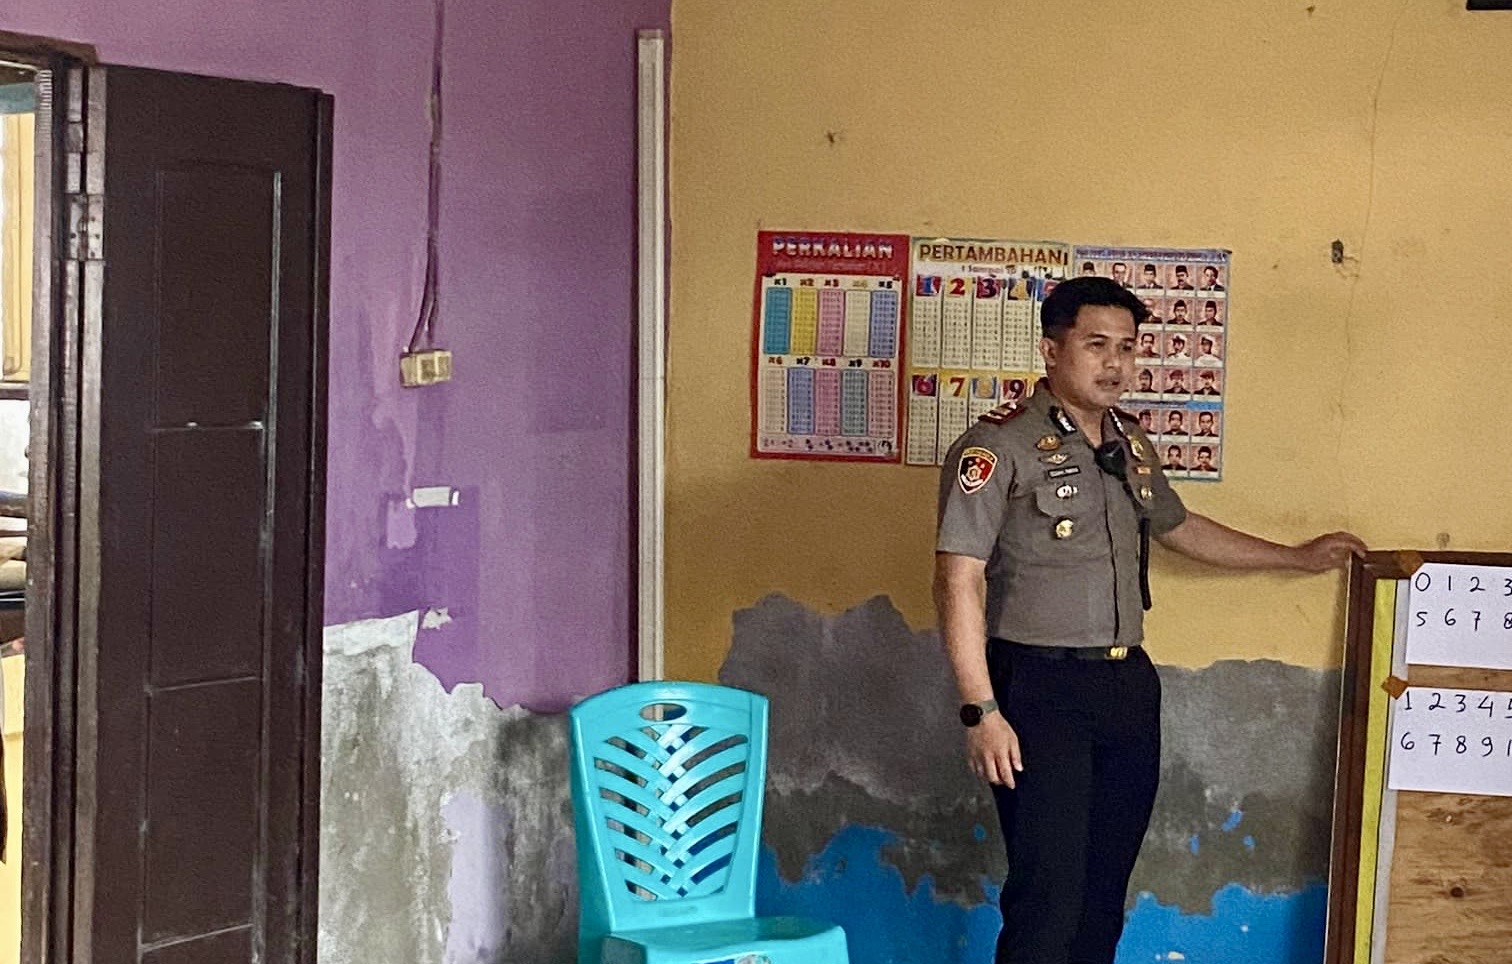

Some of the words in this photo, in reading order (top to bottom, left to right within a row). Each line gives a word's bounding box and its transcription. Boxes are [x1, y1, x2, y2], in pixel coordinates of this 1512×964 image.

[772, 237, 893, 259] PERKALIAN
[919, 244, 1062, 264] PERTAMBAHAN
[950, 278, 965, 296] 2
[950, 378, 966, 397] 7
